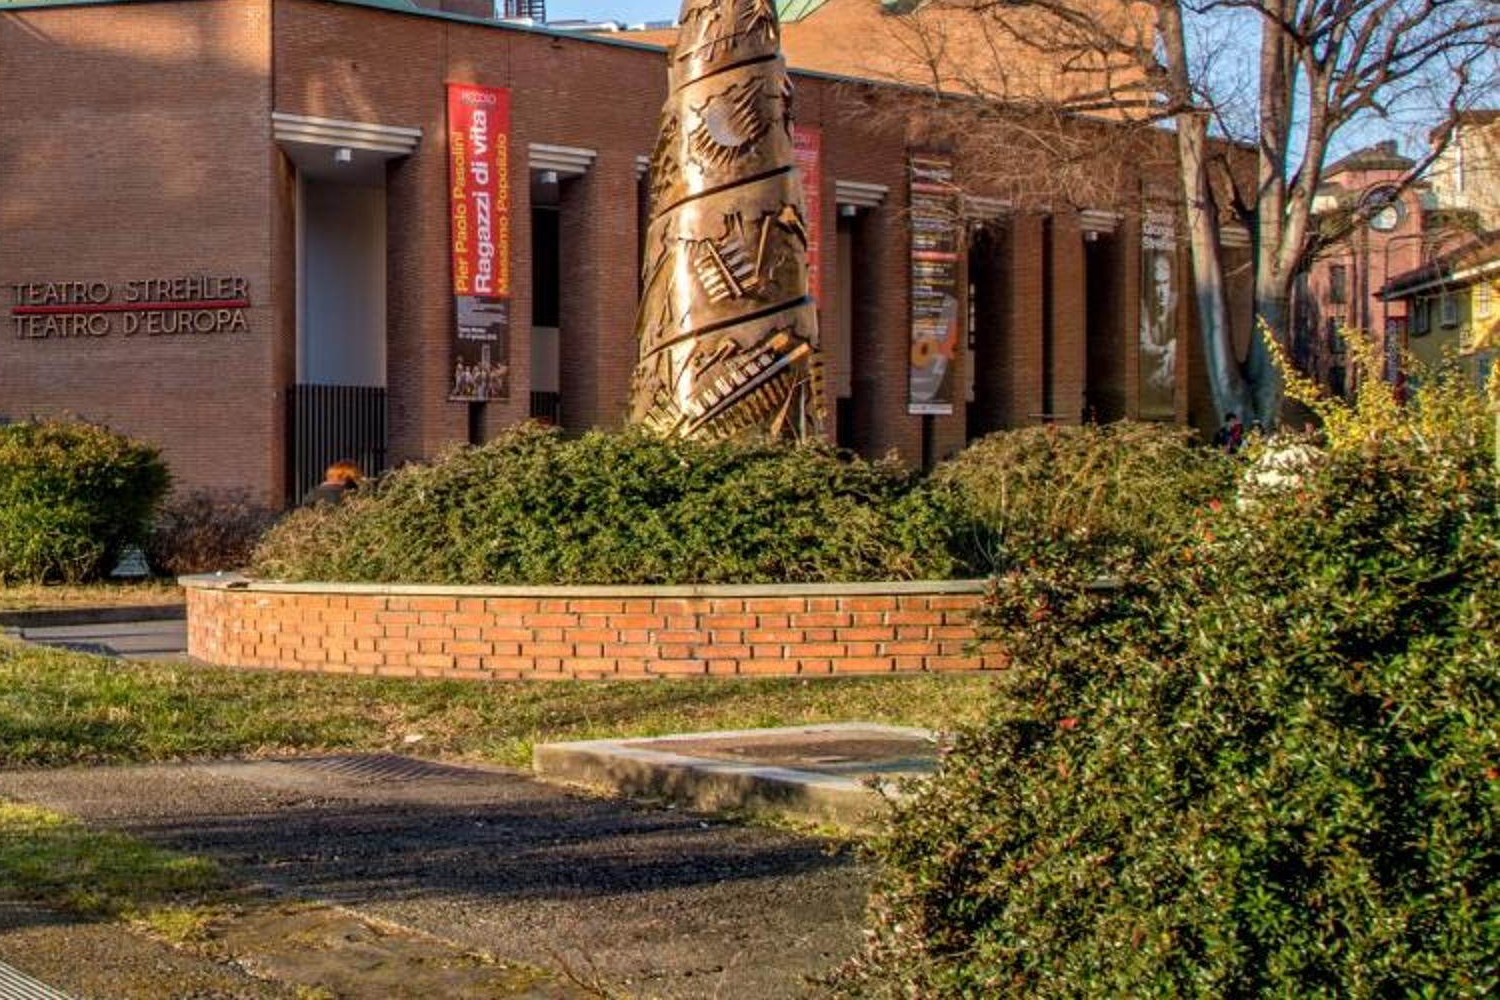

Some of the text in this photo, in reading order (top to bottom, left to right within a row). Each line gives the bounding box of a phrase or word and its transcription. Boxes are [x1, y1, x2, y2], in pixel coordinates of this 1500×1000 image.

[469, 110, 495, 294] Ragazzi di vita
[496, 133, 510, 212] Popolizio
[451, 132, 469, 293] Pier Paolo Pasolini
[12, 276, 249, 305] TEATRO STREHLER
[12, 308, 249, 339] TEATRO D'EUROPA
